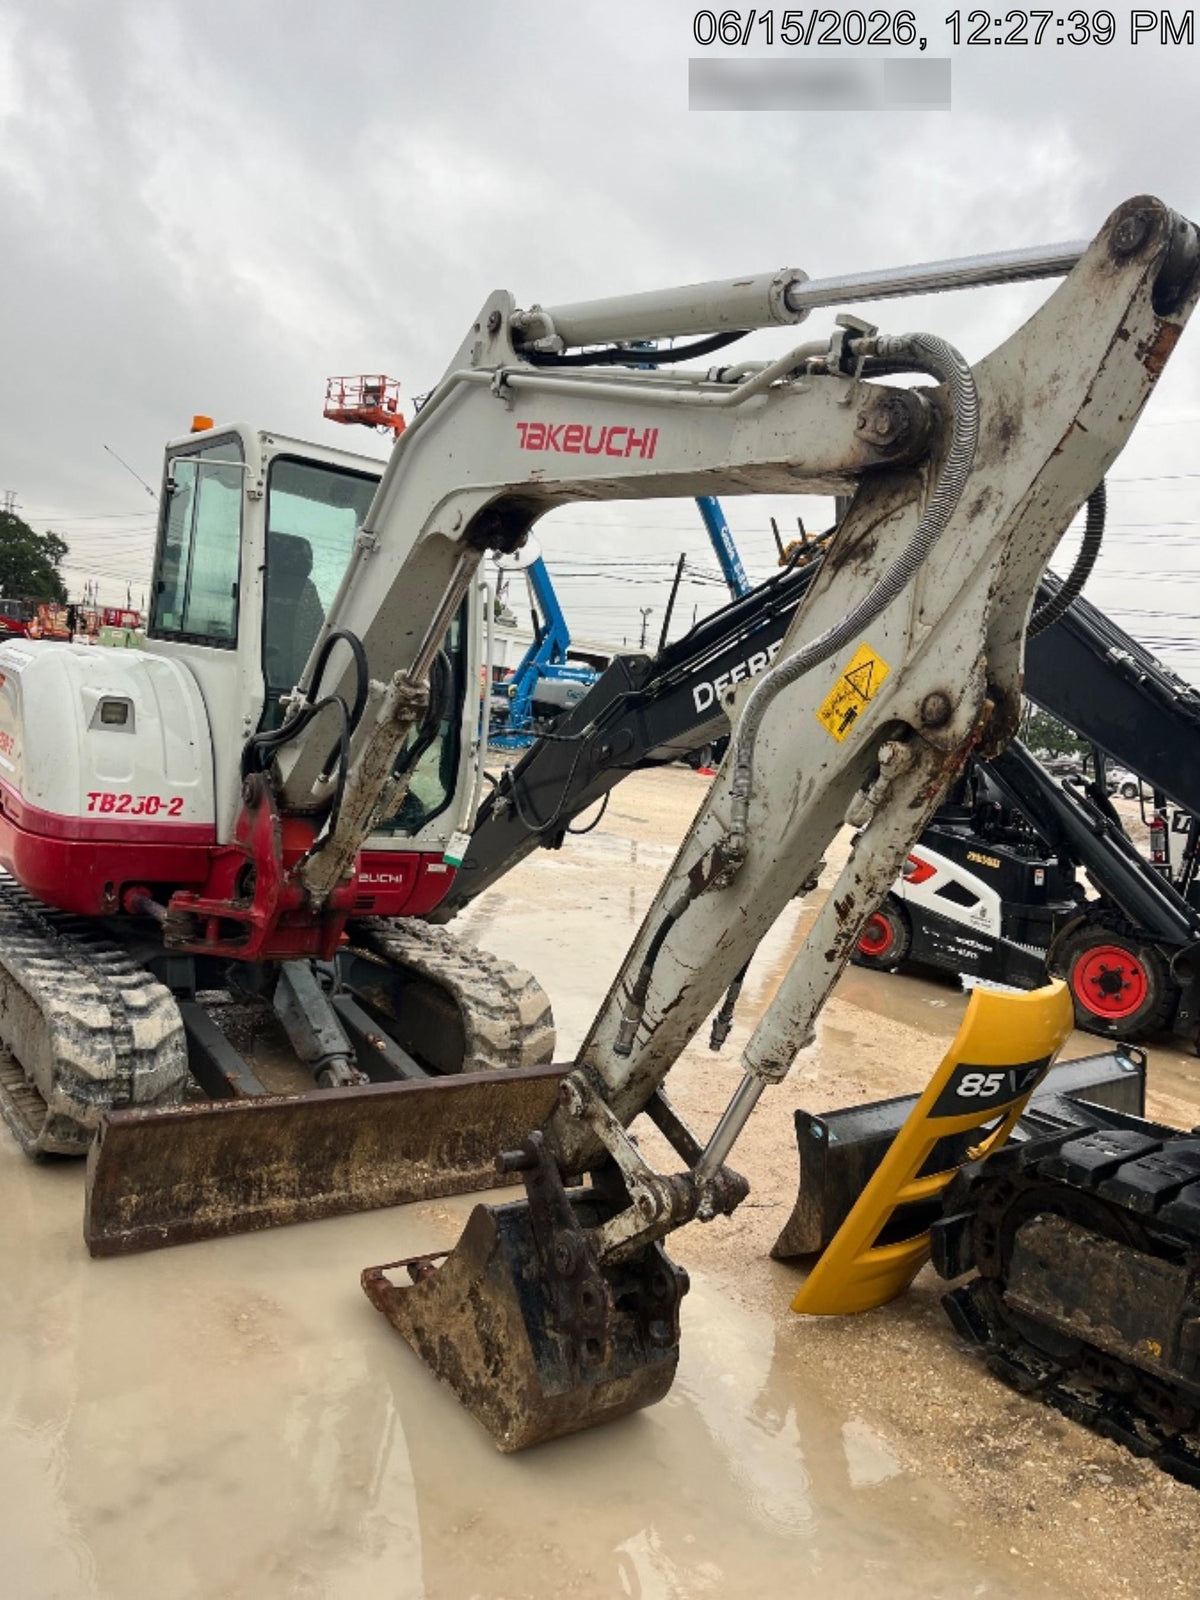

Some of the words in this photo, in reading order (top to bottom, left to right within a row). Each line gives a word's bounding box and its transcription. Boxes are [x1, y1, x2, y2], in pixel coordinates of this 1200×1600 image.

[517, 422, 659, 459] TAKEUCHI
[358, 873, 403, 884] EUCHI
[956, 1072, 1006, 1098] 85
